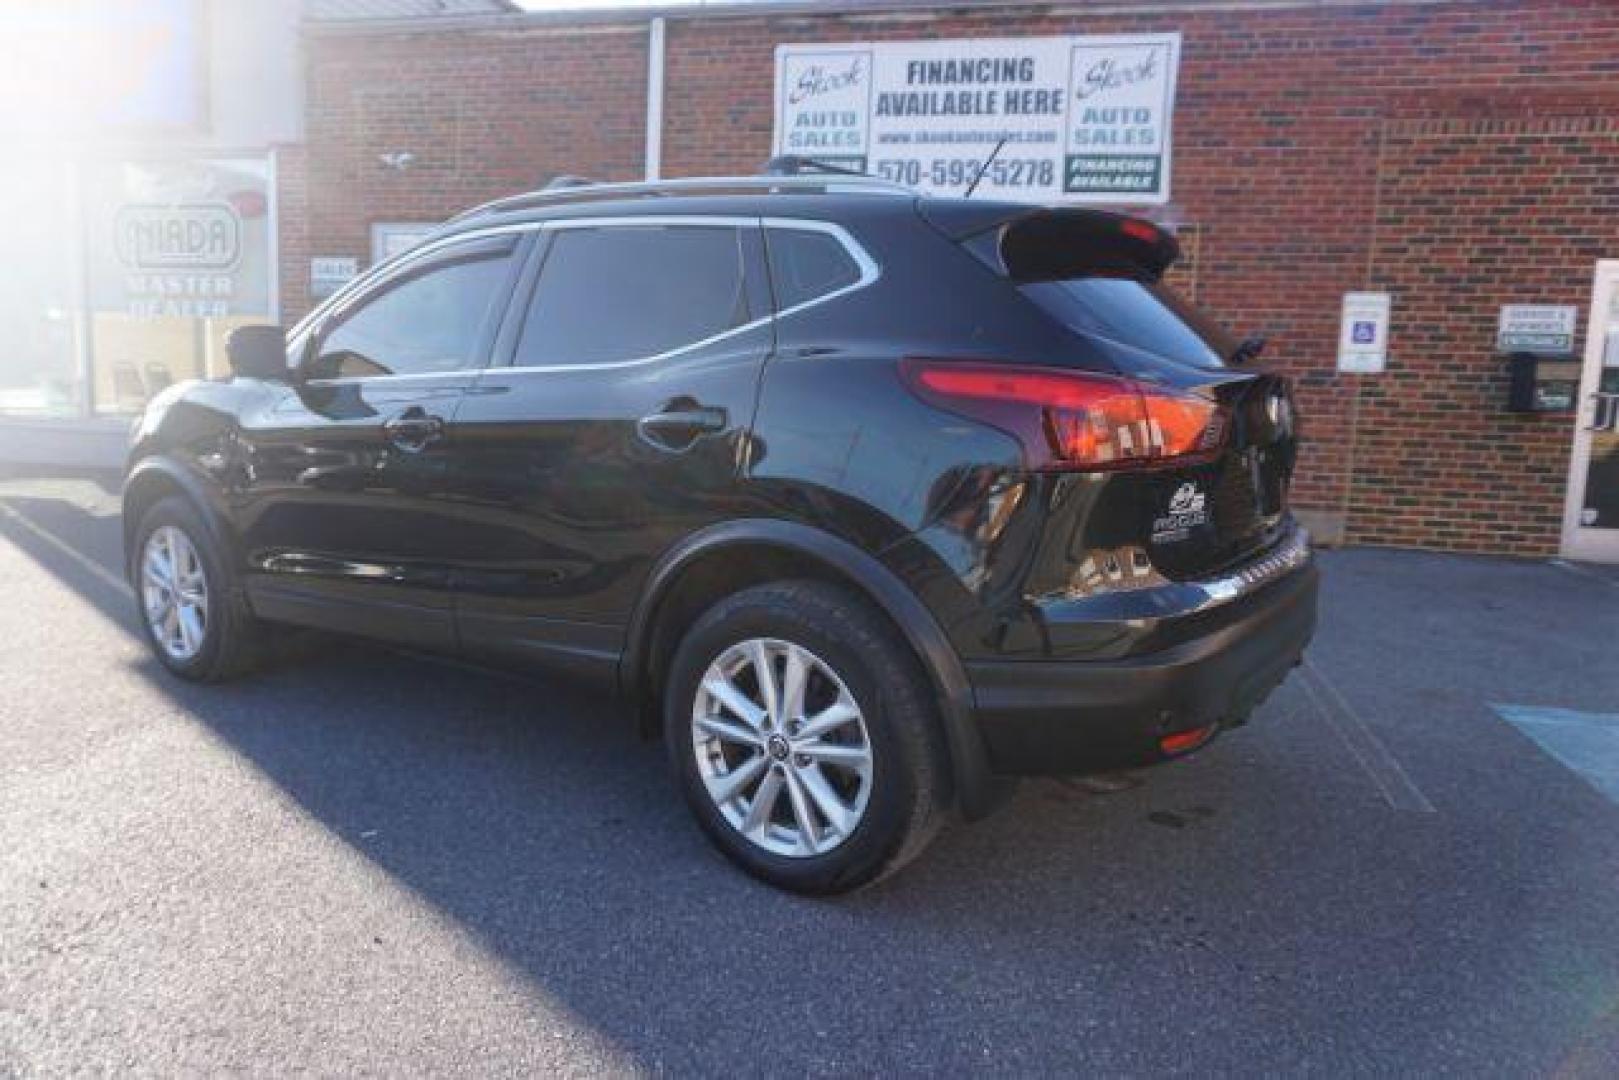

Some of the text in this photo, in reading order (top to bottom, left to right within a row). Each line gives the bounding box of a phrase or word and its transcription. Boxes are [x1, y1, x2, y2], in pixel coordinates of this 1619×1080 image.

[907, 57, 1034, 84] FINANCING
[876, 88, 1064, 116] AVAILABLE HERE
[795, 111, 856, 128] AUTO
[1080, 107, 1149, 124] AUTO
[789, 130, 861, 147] SALES
[1074, 128, 1154, 144] SALES
[878, 158, 1054, 187] 570-593-5278
[1071, 158, 1155, 173] FINANCING
[130, 218, 226, 255] NIADA
